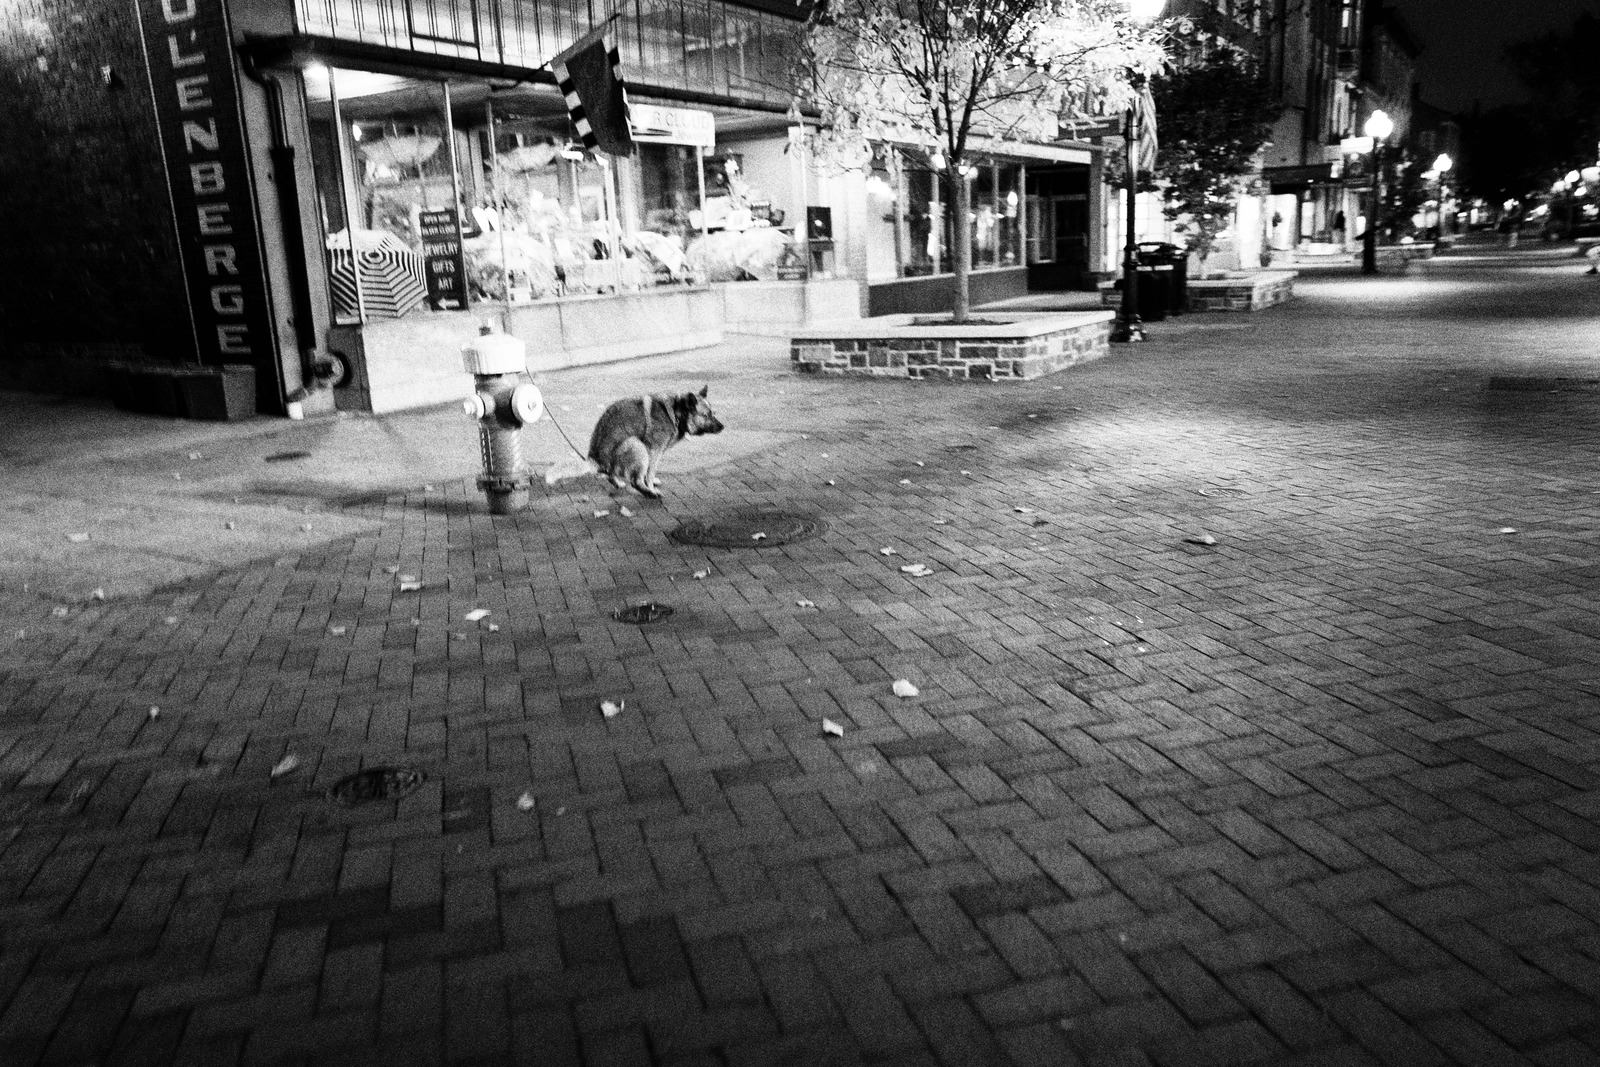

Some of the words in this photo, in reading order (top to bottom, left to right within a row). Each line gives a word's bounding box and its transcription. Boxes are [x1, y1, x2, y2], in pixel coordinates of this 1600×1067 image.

[424, 241, 458, 257] JEWELRY
[432, 260, 455, 273] GIFTS
[438, 277, 453, 290] ART
